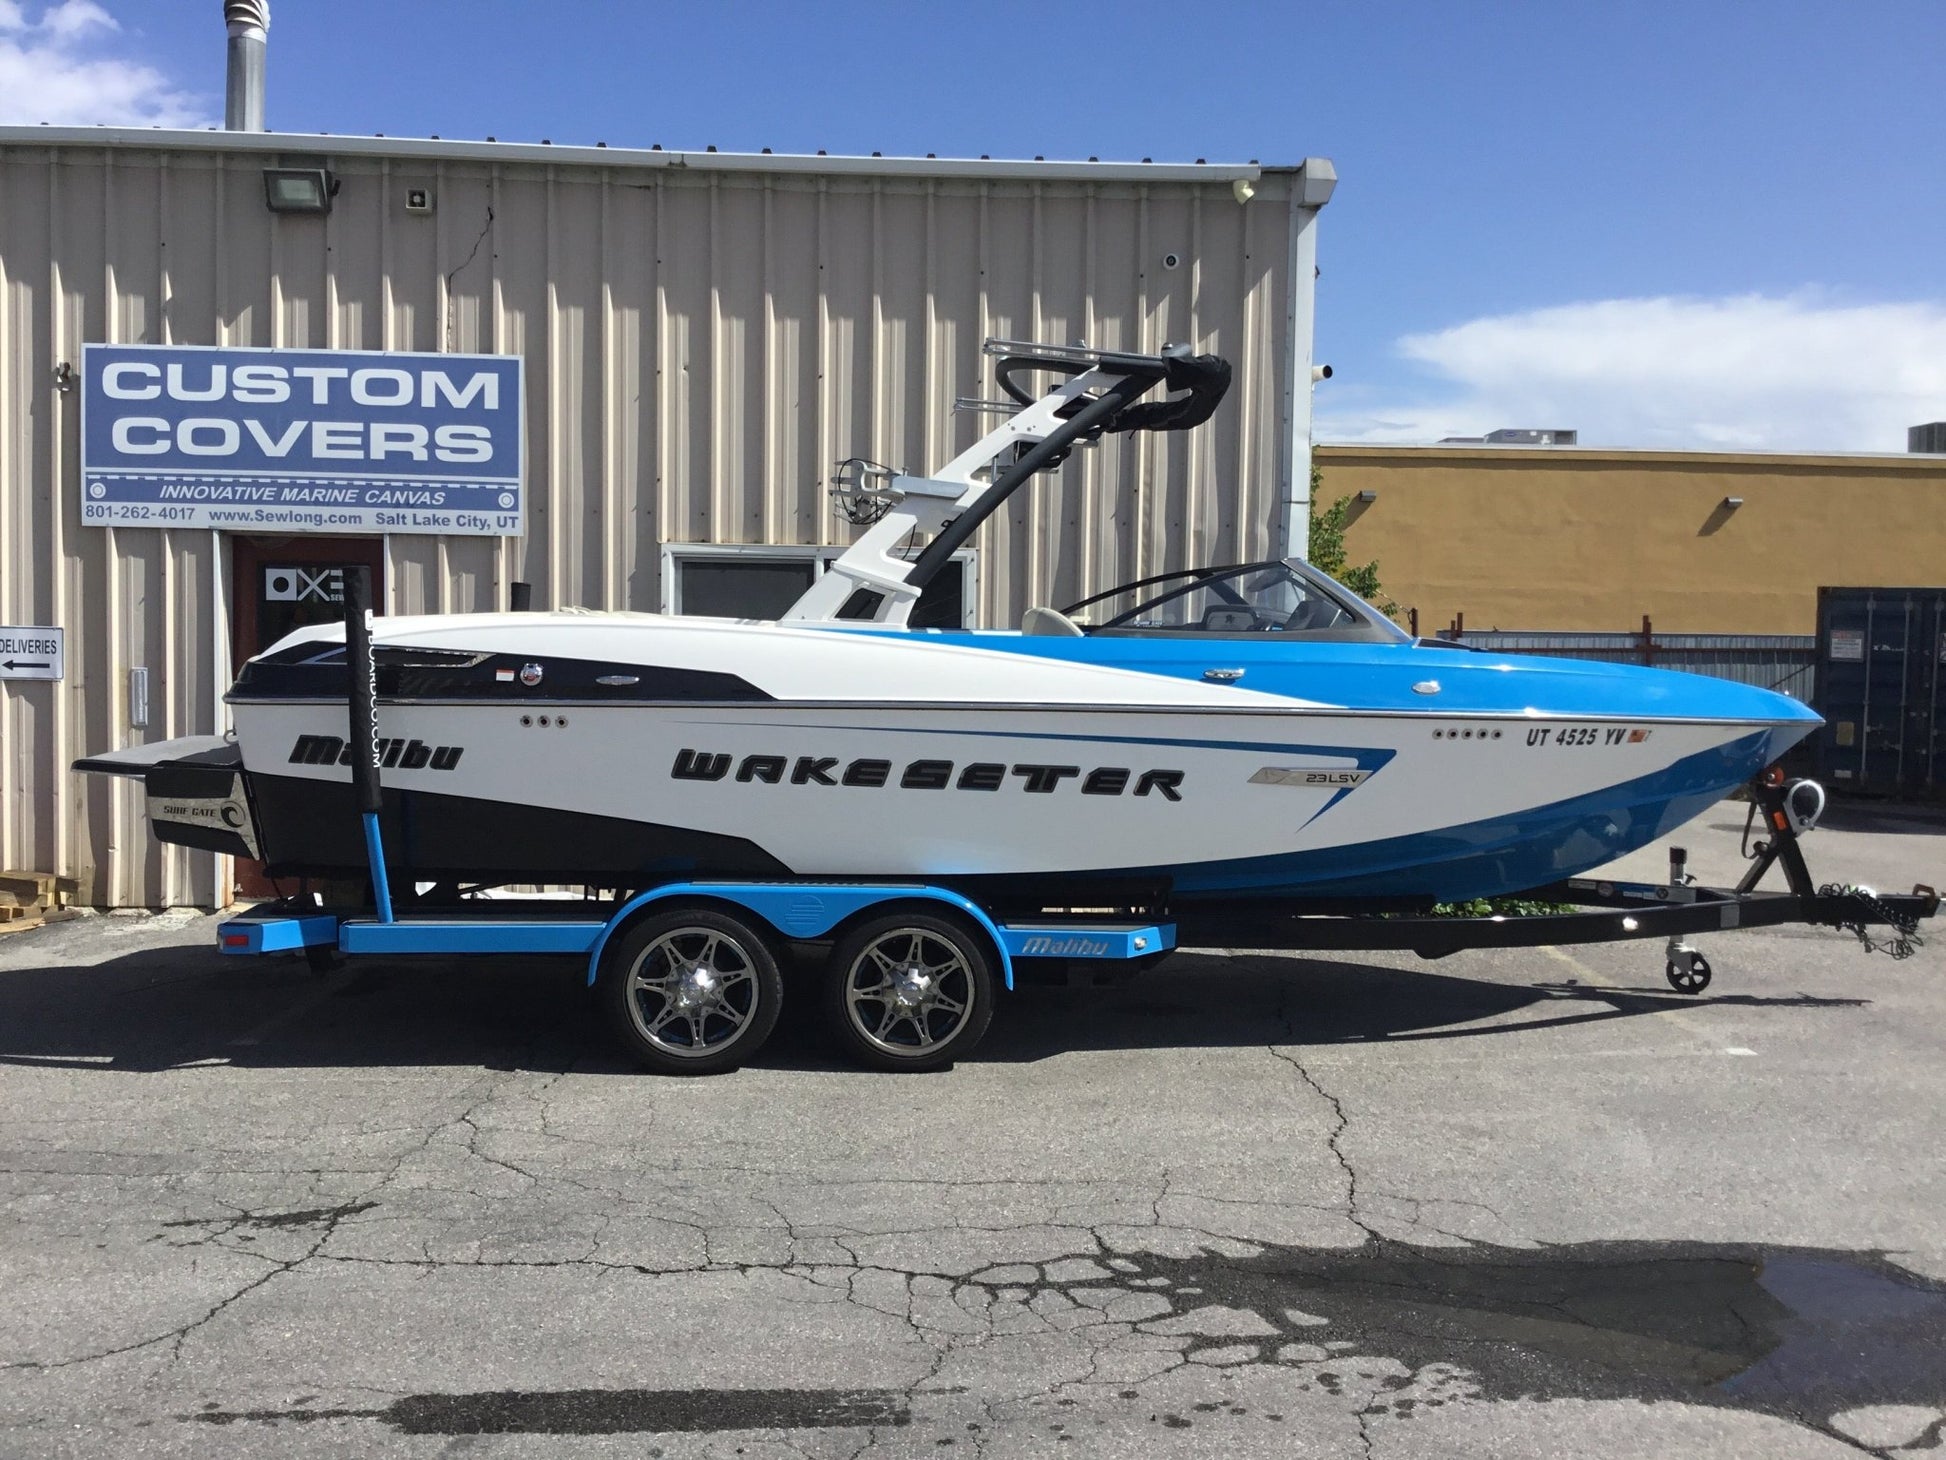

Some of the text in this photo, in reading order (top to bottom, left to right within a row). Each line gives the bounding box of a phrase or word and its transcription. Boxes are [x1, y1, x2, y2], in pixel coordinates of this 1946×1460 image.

[102, 362, 499, 410] CUSTOM
[111, 417, 494, 463] COVERS
[159, 485, 446, 505] INNOVATIVE MARINE CANVAS
[85, 505, 519, 531] 801-262-4017 www.Sewlong.com Salt Lake City, UT
[0, 638, 57, 655] DELIVERIES
[1526, 728, 1627, 747] UT 4525 YV
[671, 748, 1185, 802] WAKESETTER
[1305, 773, 1361, 784] 23LSV
[192, 807, 216, 817] GATE
[1022, 937, 1108, 955] Malibu
